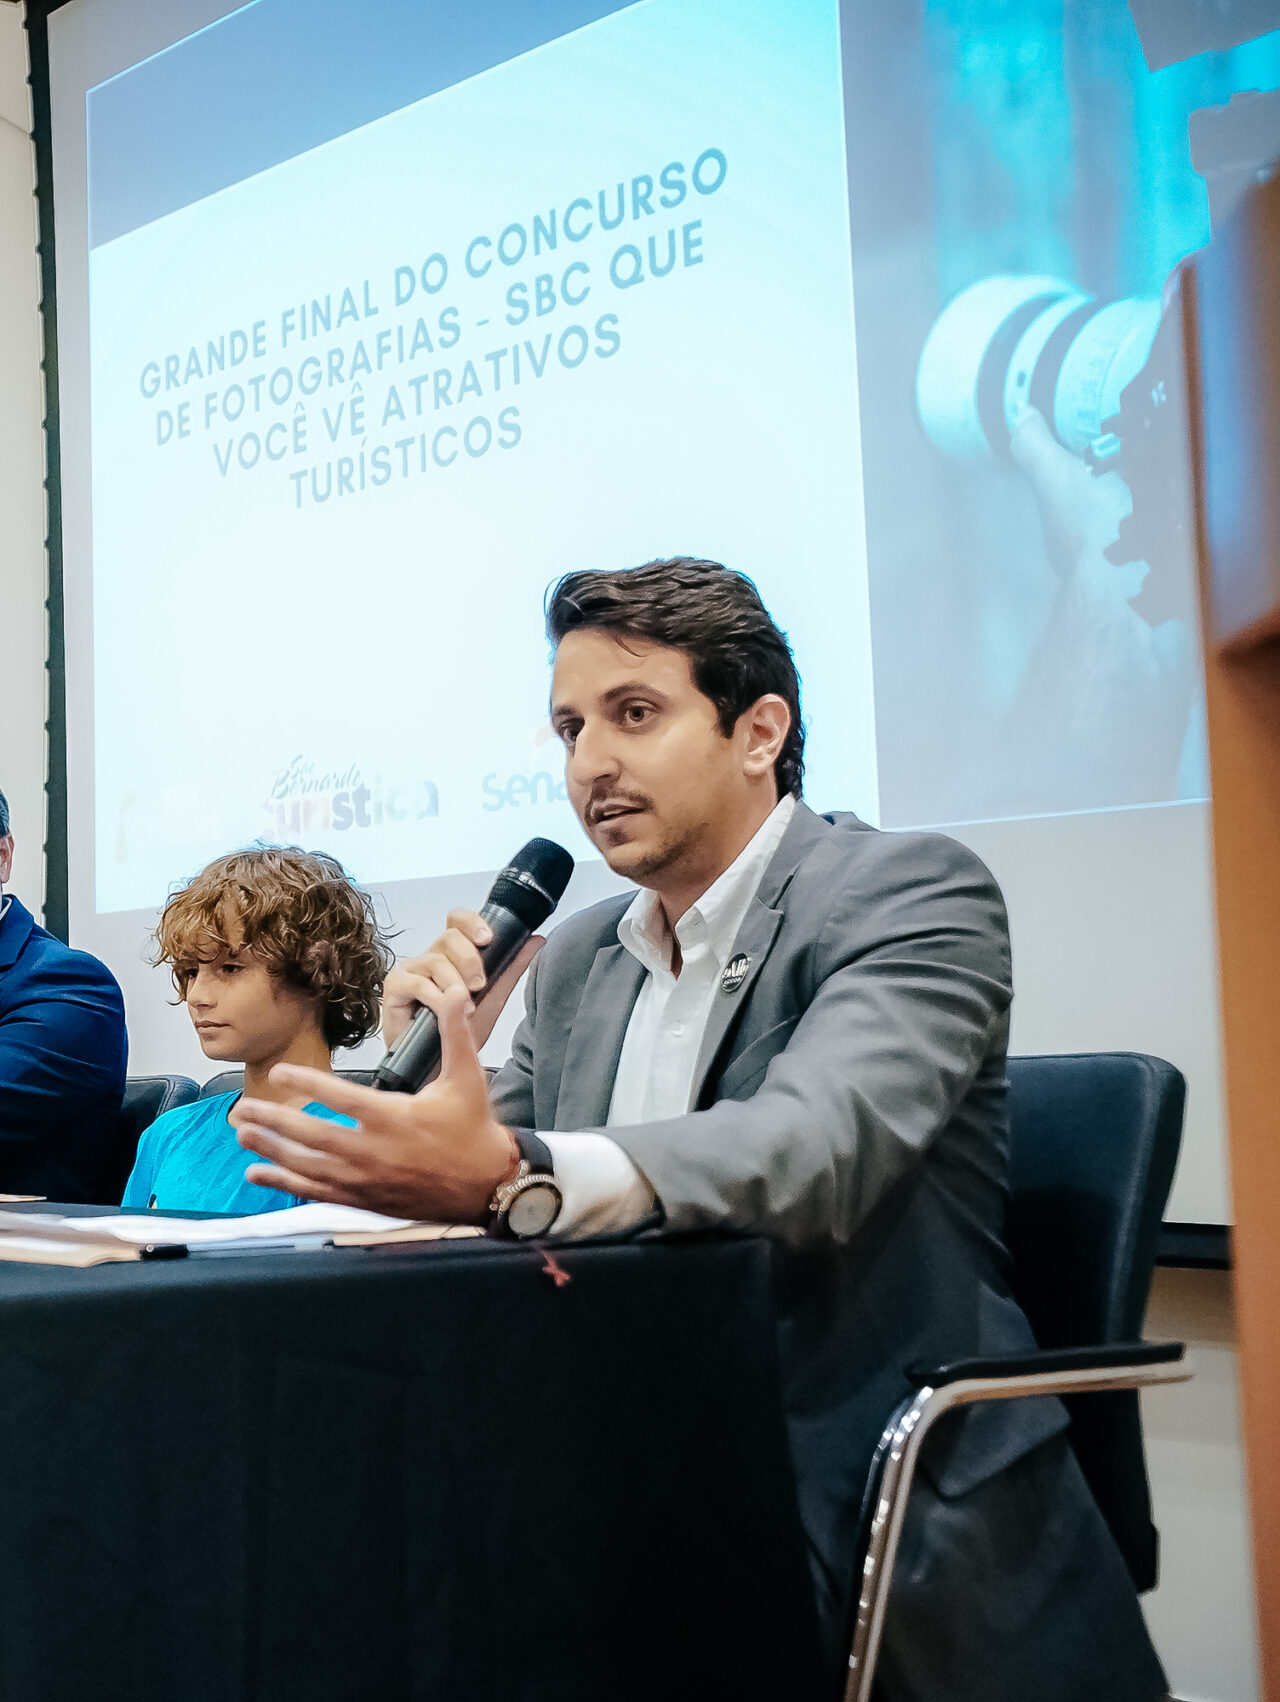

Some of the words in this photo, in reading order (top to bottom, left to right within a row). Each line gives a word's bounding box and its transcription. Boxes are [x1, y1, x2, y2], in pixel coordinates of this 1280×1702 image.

[139, 321, 268, 399] GRANDE
[281, 279, 380, 348] FINAL
[393, 252, 449, 306] DO
[464, 147, 728, 278] CONCURSO
[155, 401, 192, 447] DE
[204, 305, 461, 430] FOTOGRAFIAS
[505, 261, 591, 326] SBC
[609, 219, 705, 290] QUE
[212, 401, 308, 478] VOCÊ
[322, 380, 366, 443] VÊ
[381, 312, 621, 427] ATRATIVOS
[289, 405, 523, 509] TURÍSTICOS
